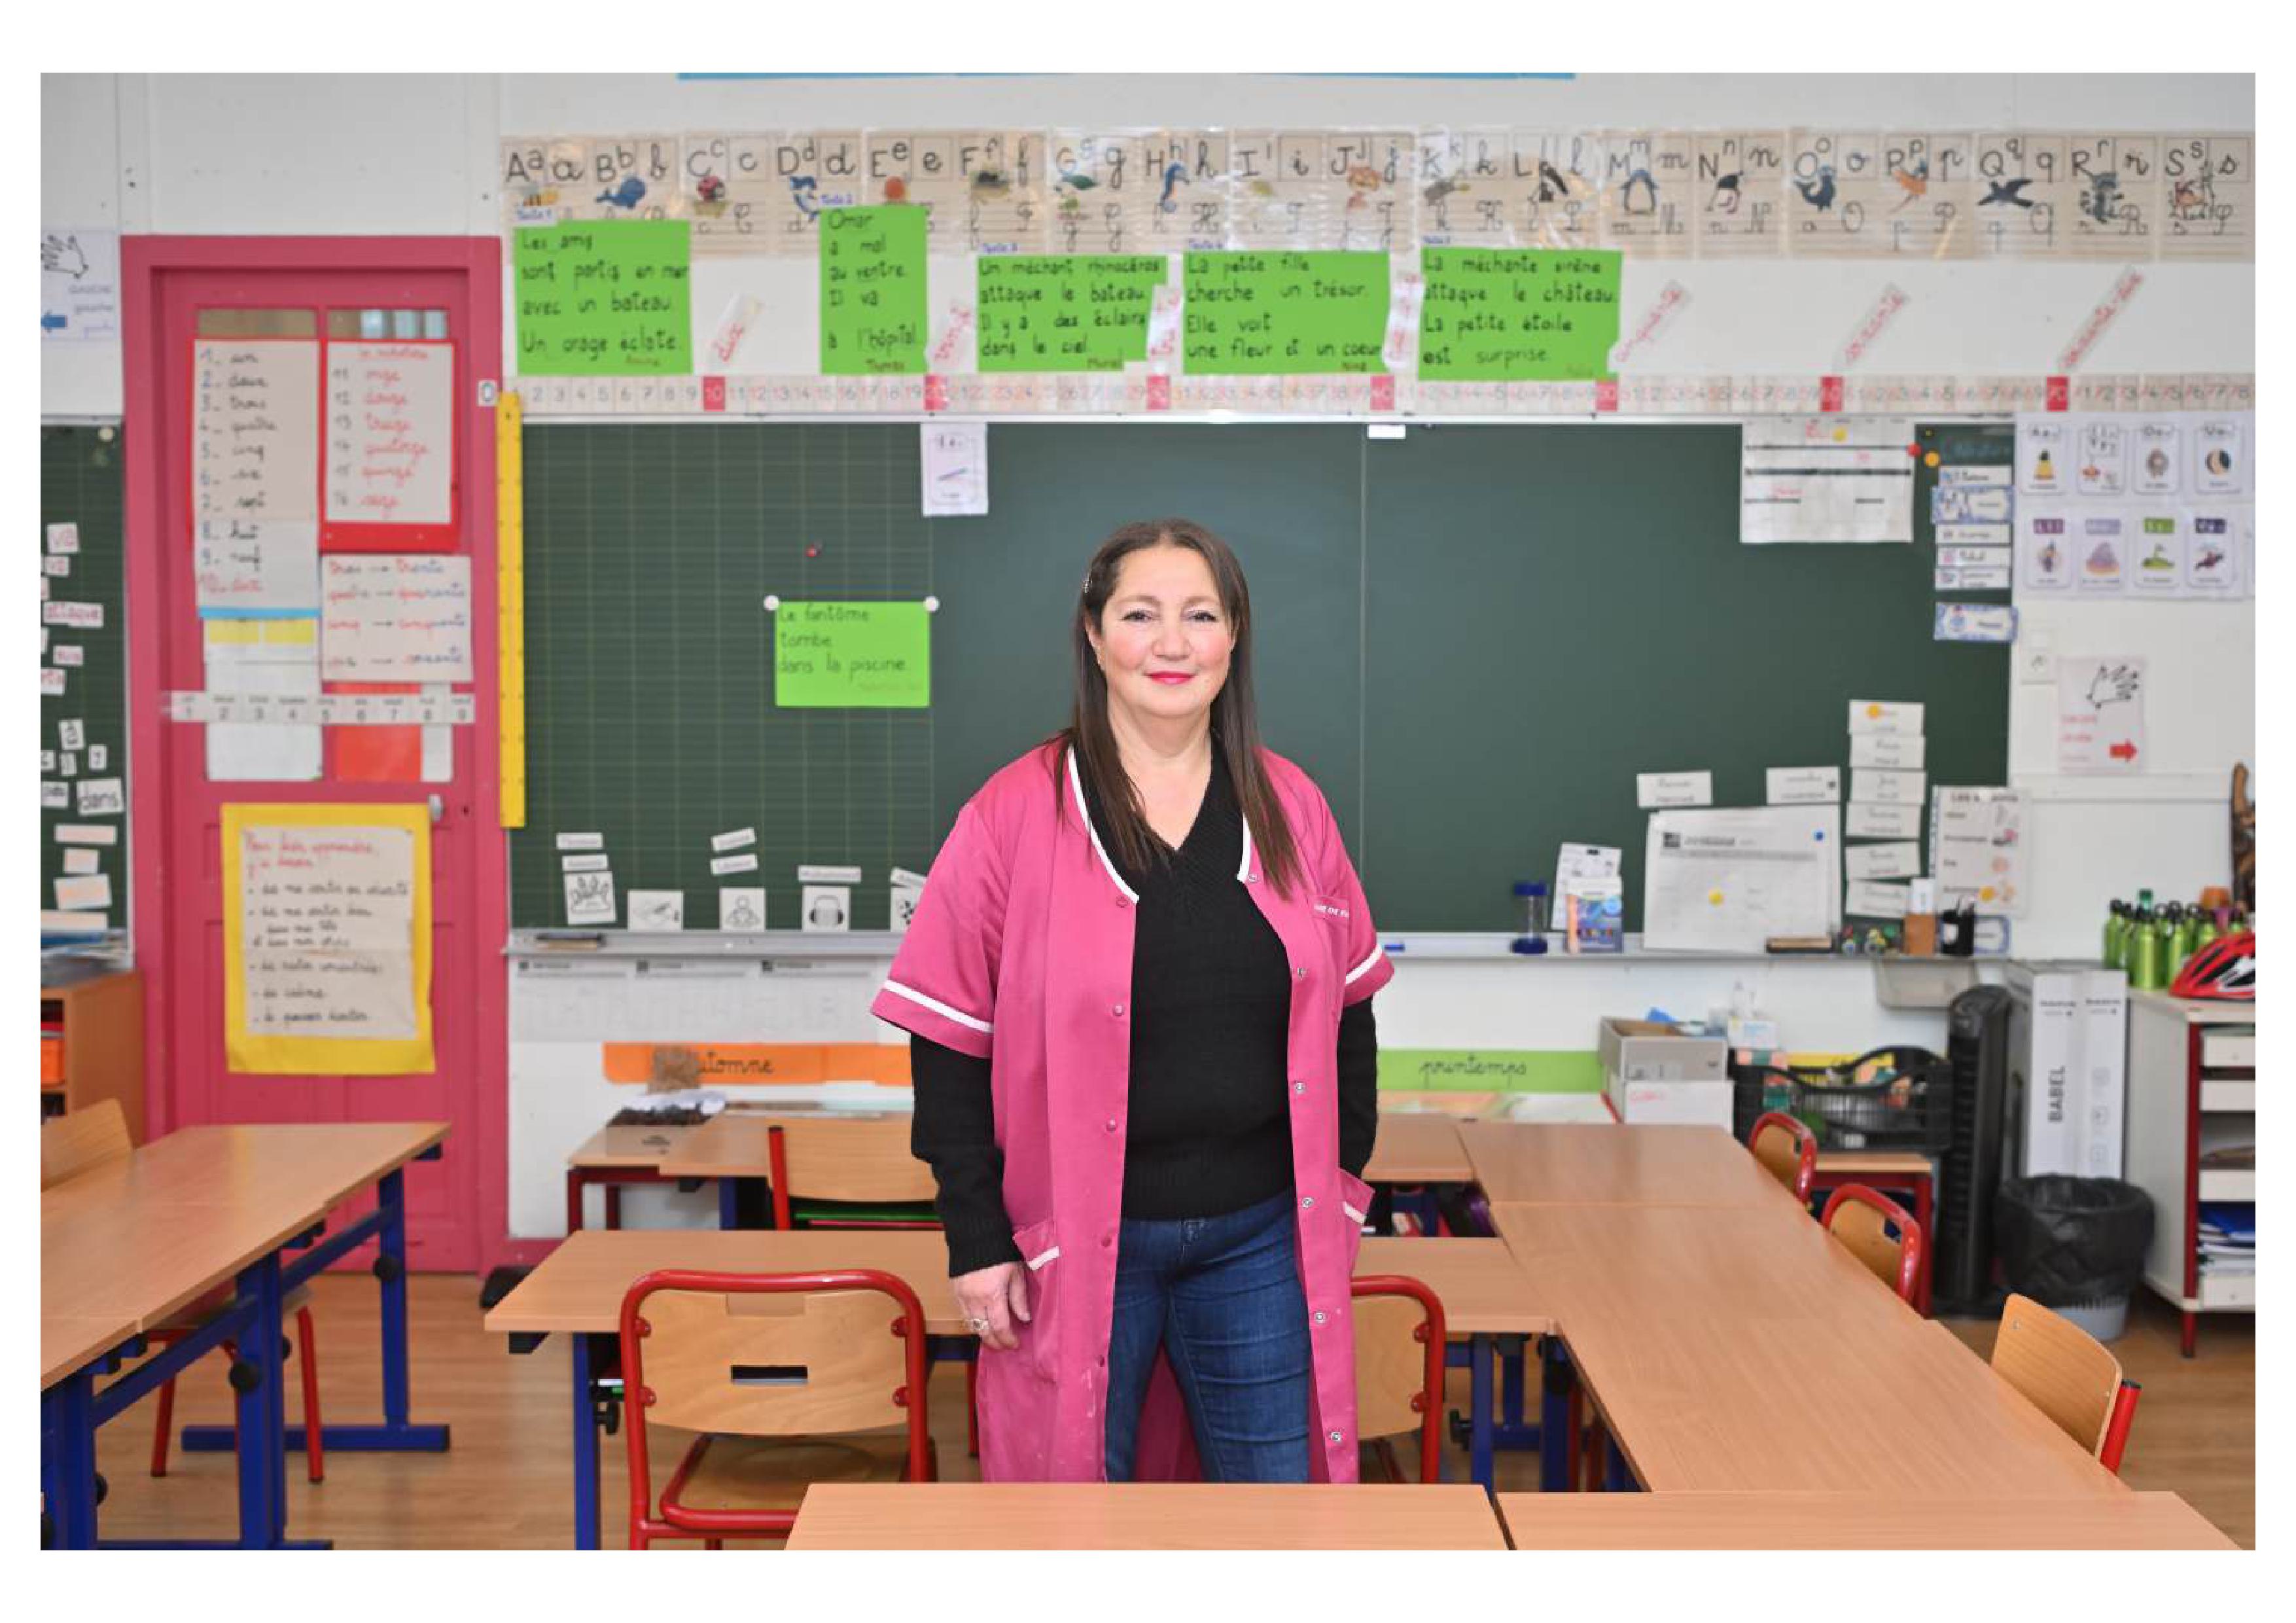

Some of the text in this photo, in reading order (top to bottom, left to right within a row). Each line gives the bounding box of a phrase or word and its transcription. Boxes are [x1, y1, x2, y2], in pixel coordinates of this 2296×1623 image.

[860, 233, 886, 254] mal
[1012, 258, 1074, 276] méchant
[1188, 252, 1310, 280] La petite fille
[1424, 247, 1444, 272] La
[1462, 250, 1538, 274] méchante
[522, 260, 556, 283] sont
[574, 259, 620, 292] partis
[635, 264, 655, 279] en
[861, 289, 878, 306] va
[981, 284, 1042, 310] attaque
[1062, 281, 1074, 303] le
[1186, 279, 1254, 303] cherche
[1280, 284, 1302, 299] un
[1424, 282, 1487, 311] attaque
[1513, 278, 1527, 302] le
[523, 300, 562, 315] avec
[577, 297, 597, 315] un
[1054, 309, 1080, 328] des
[1187, 312, 1272, 334] Elle voit
[1424, 312, 1573, 341] La petite étoile
[522, 329, 546, 353] Un
[562, 337, 609, 362] orage
[982, 336, 1016, 359] dans
[1033, 332, 1047, 354] le
[1187, 336, 1382, 359] une fleur et un coeur
[1422, 345, 1451, 366] est
[779, 602, 870, 623] Le fantôme
[779, 631, 832, 649] tombe
[779, 655, 814, 675] dans
[826, 652, 841, 673] la
[1419, 1054, 1527, 1089] printemps
[2047, 1065, 2066, 1123] BABEL
